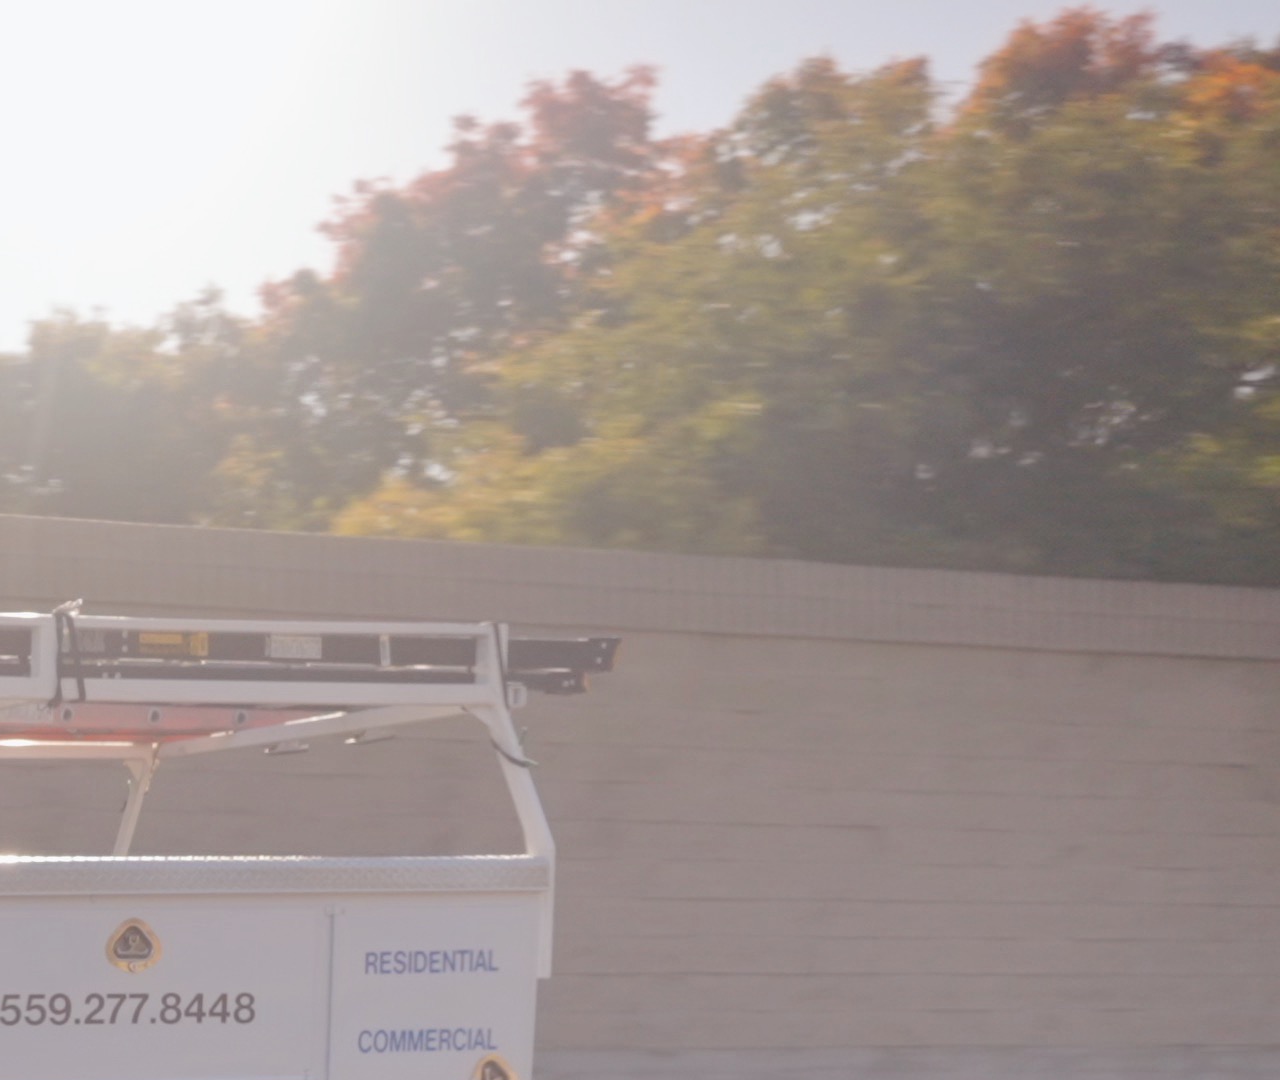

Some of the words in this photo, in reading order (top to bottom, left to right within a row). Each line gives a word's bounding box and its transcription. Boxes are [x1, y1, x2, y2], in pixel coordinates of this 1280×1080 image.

[364, 950, 499, 975] RESIDENTIAL
[0, 992, 256, 1026] 559.277.8448
[358, 1028, 497, 1053] COMMERCIAL
